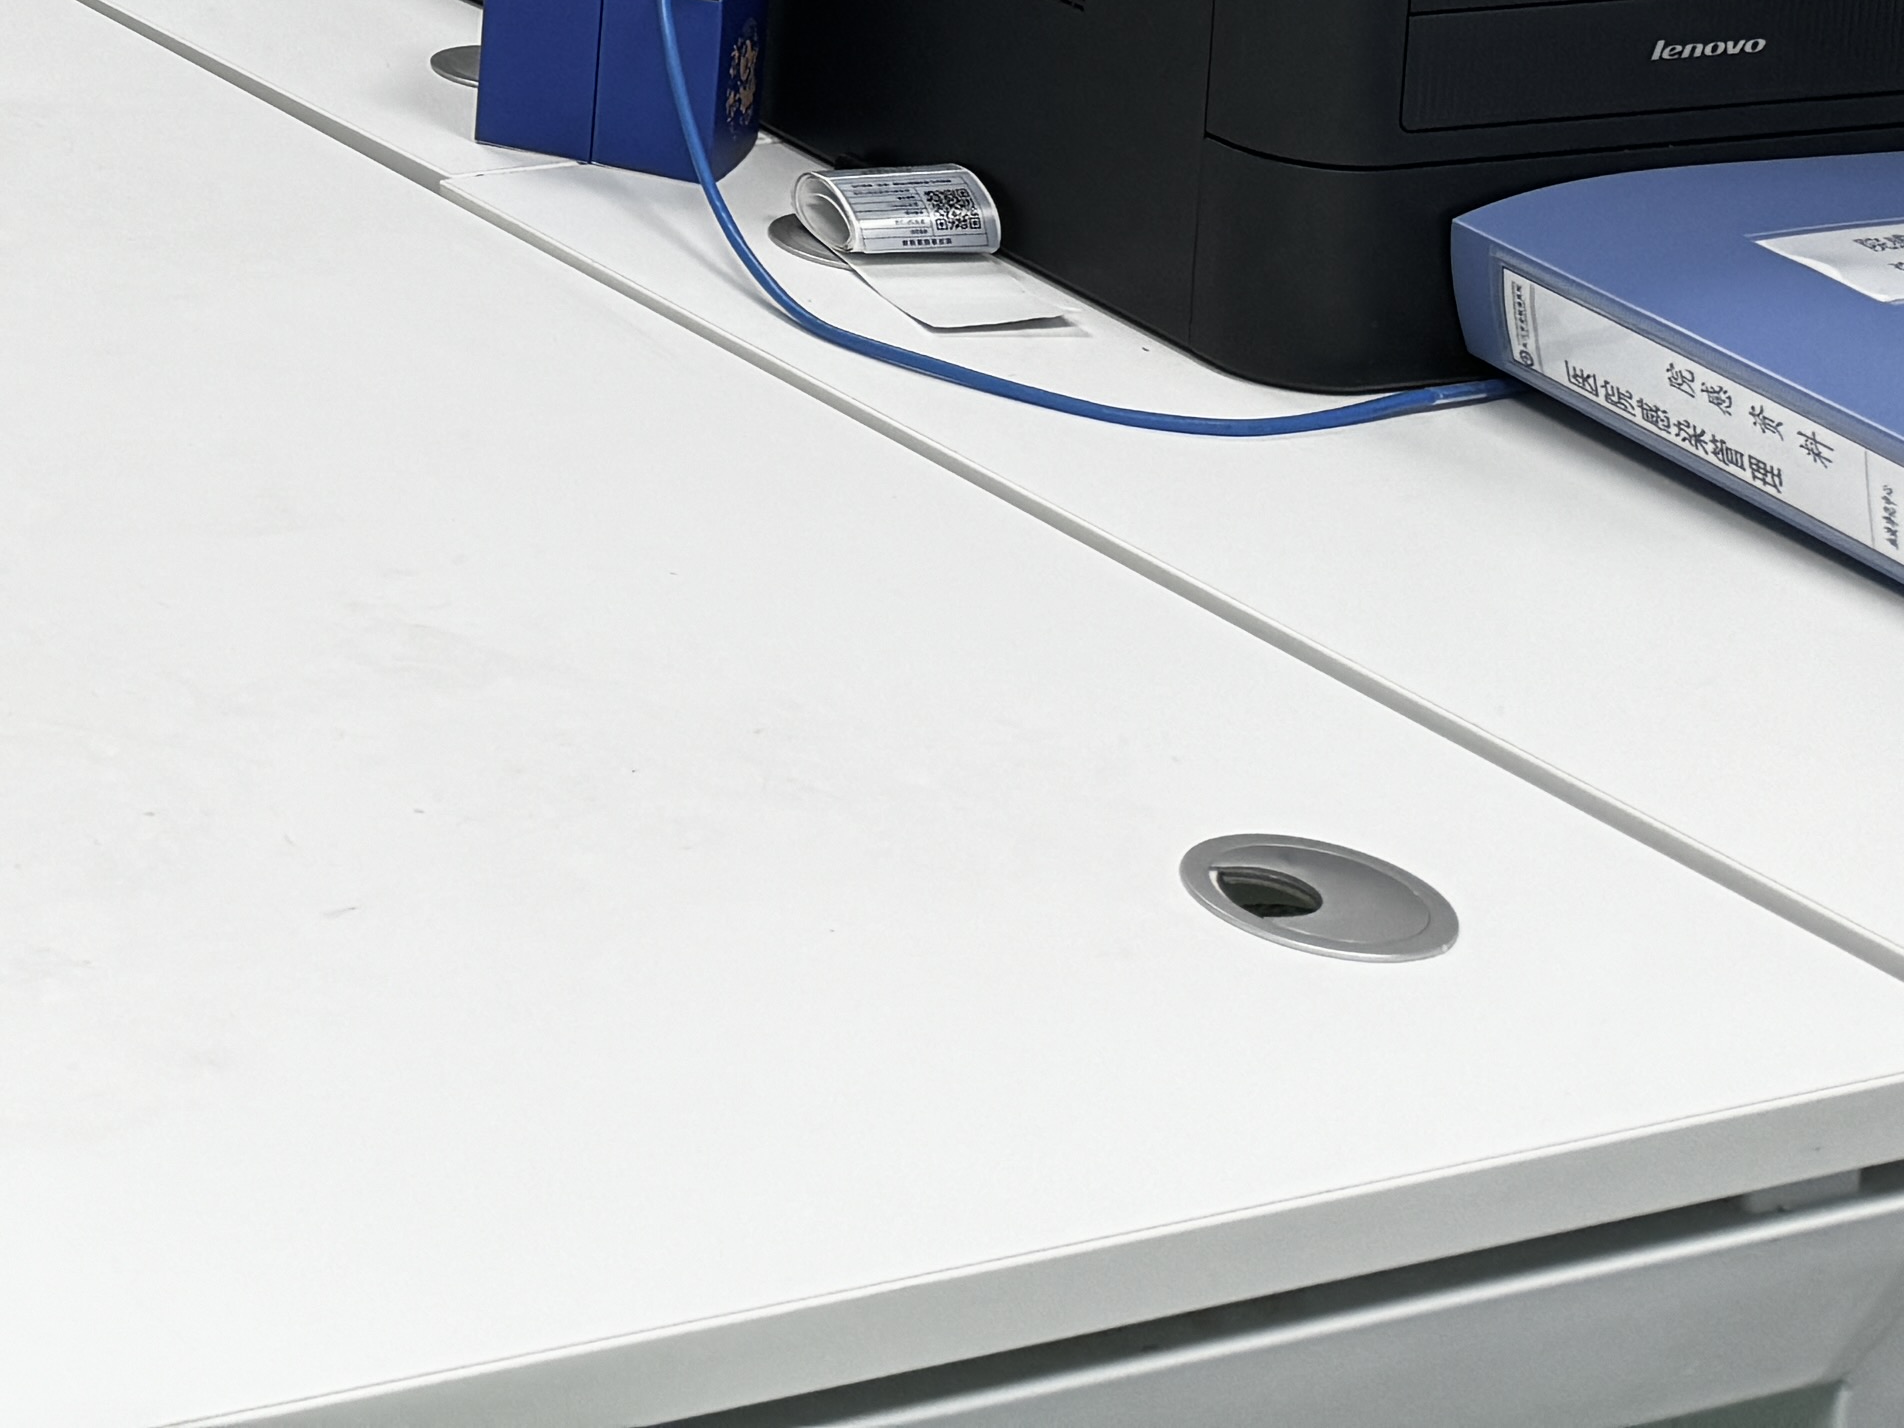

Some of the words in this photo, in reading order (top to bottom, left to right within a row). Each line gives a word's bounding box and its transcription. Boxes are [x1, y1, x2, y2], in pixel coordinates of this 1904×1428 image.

[1650, 38, 1766, 62] lenovo
[1564, 360, 1784, 494] 医院感染管理
[1666, 362, 1835, 469] 院感资料
